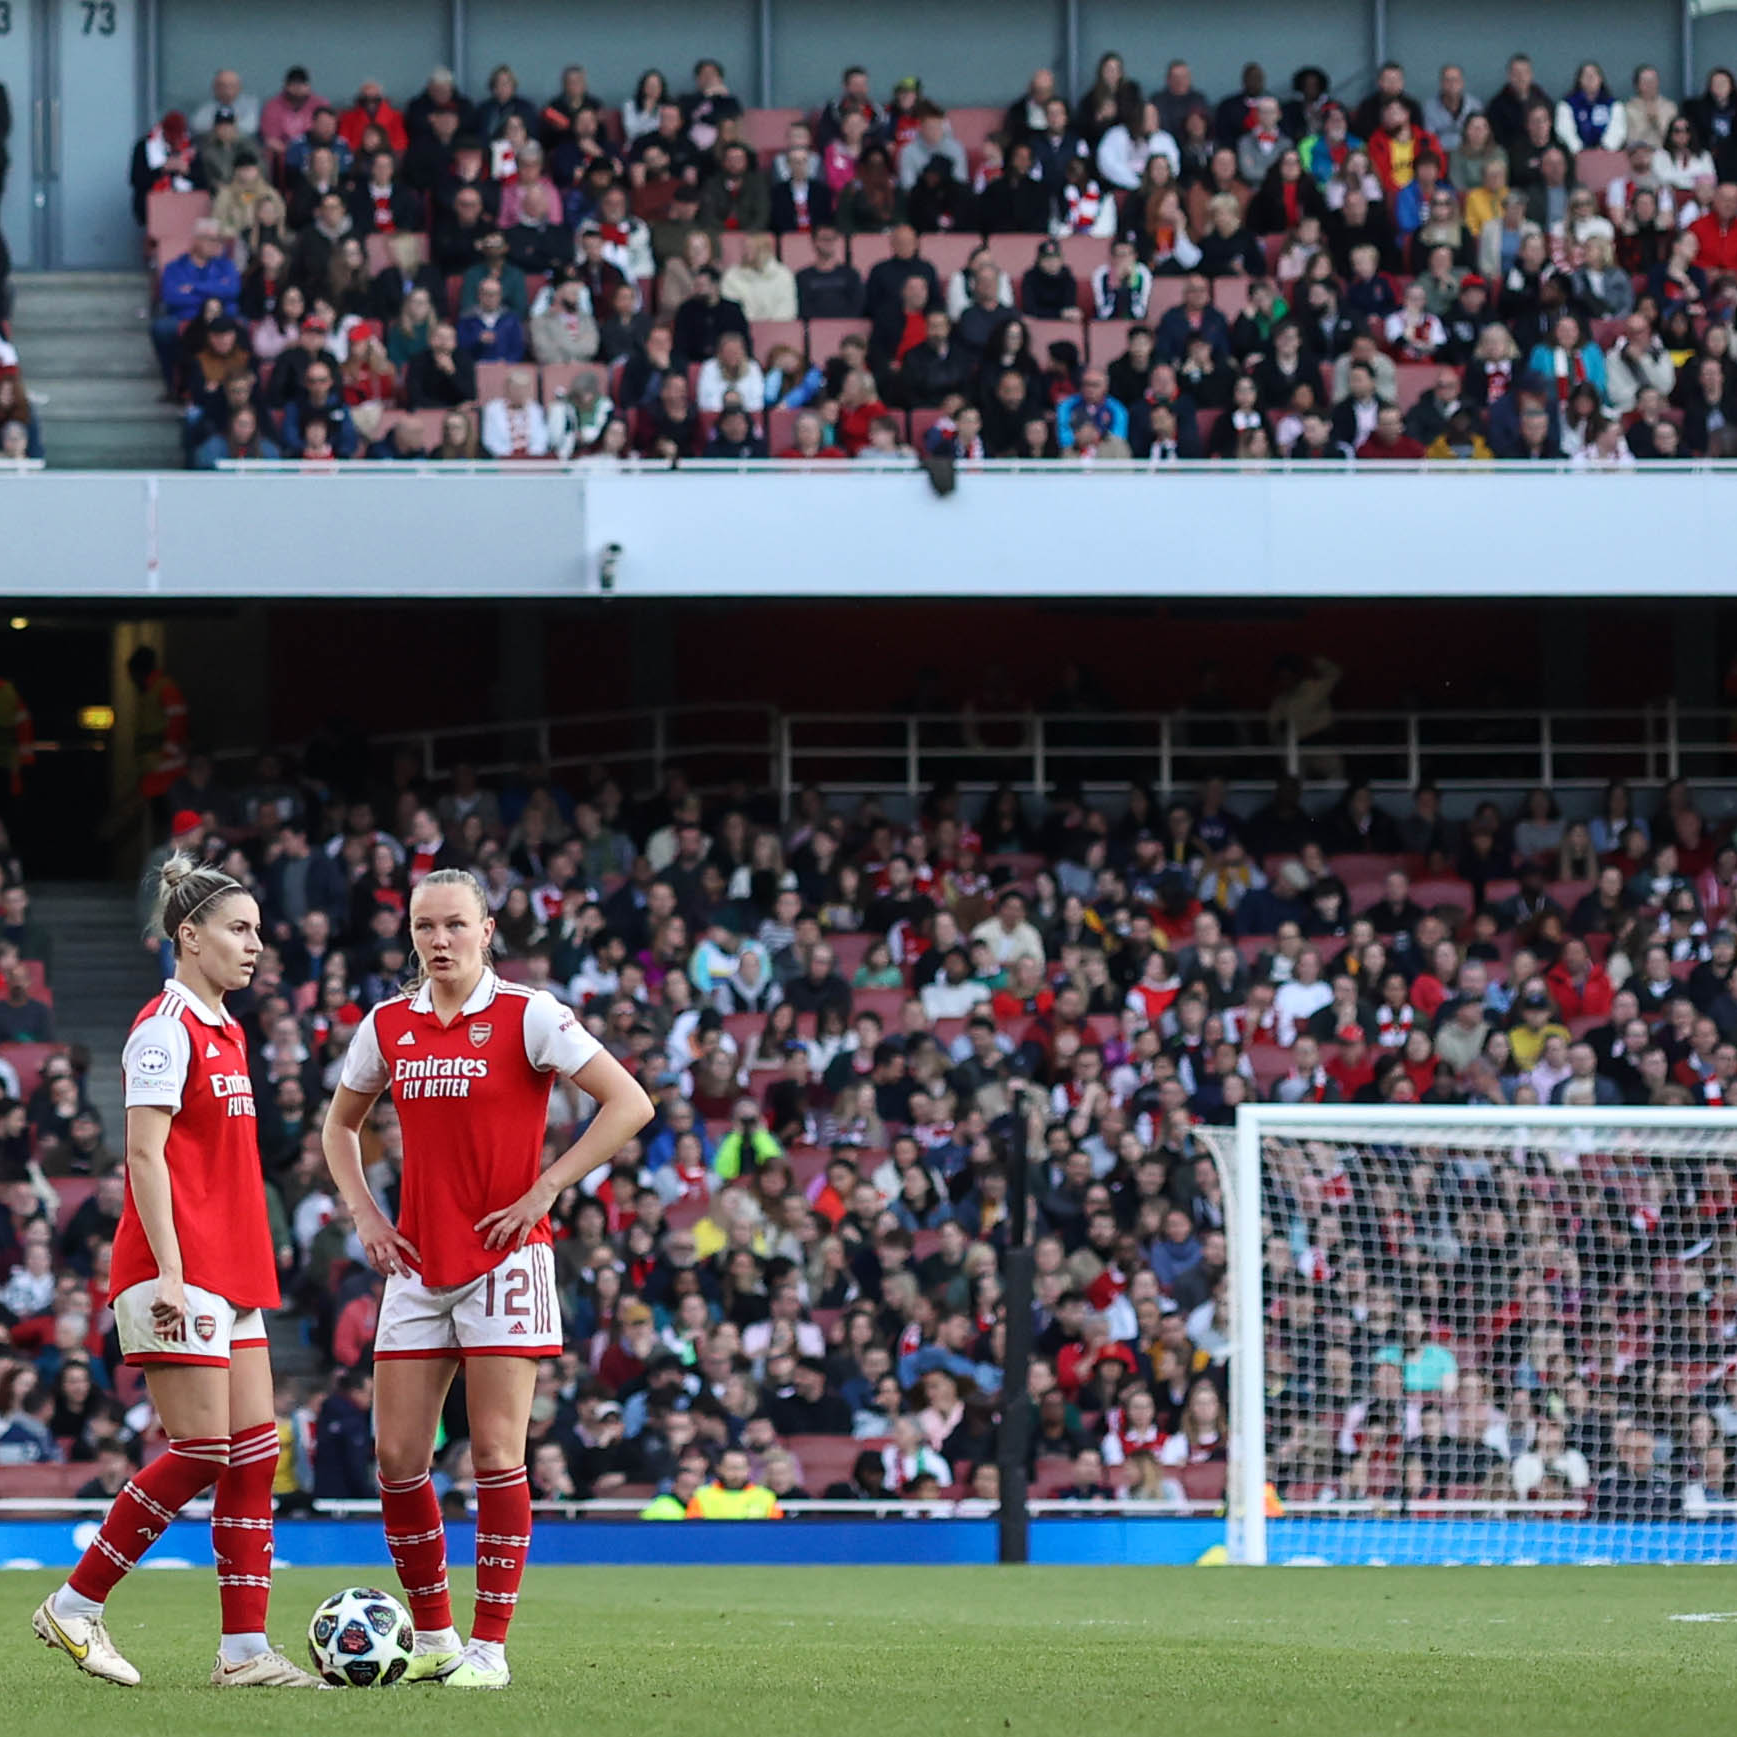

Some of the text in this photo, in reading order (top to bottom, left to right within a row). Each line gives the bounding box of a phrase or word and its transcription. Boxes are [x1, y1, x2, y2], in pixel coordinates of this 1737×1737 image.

[79, 0, 116, 36] 73
[394, 1054, 488, 1082] Emirates
[403, 1078, 470, 1100] FLY BETTER
[485, 1268, 530, 1317] 12
[477, 1555, 516, 1569] AFC
